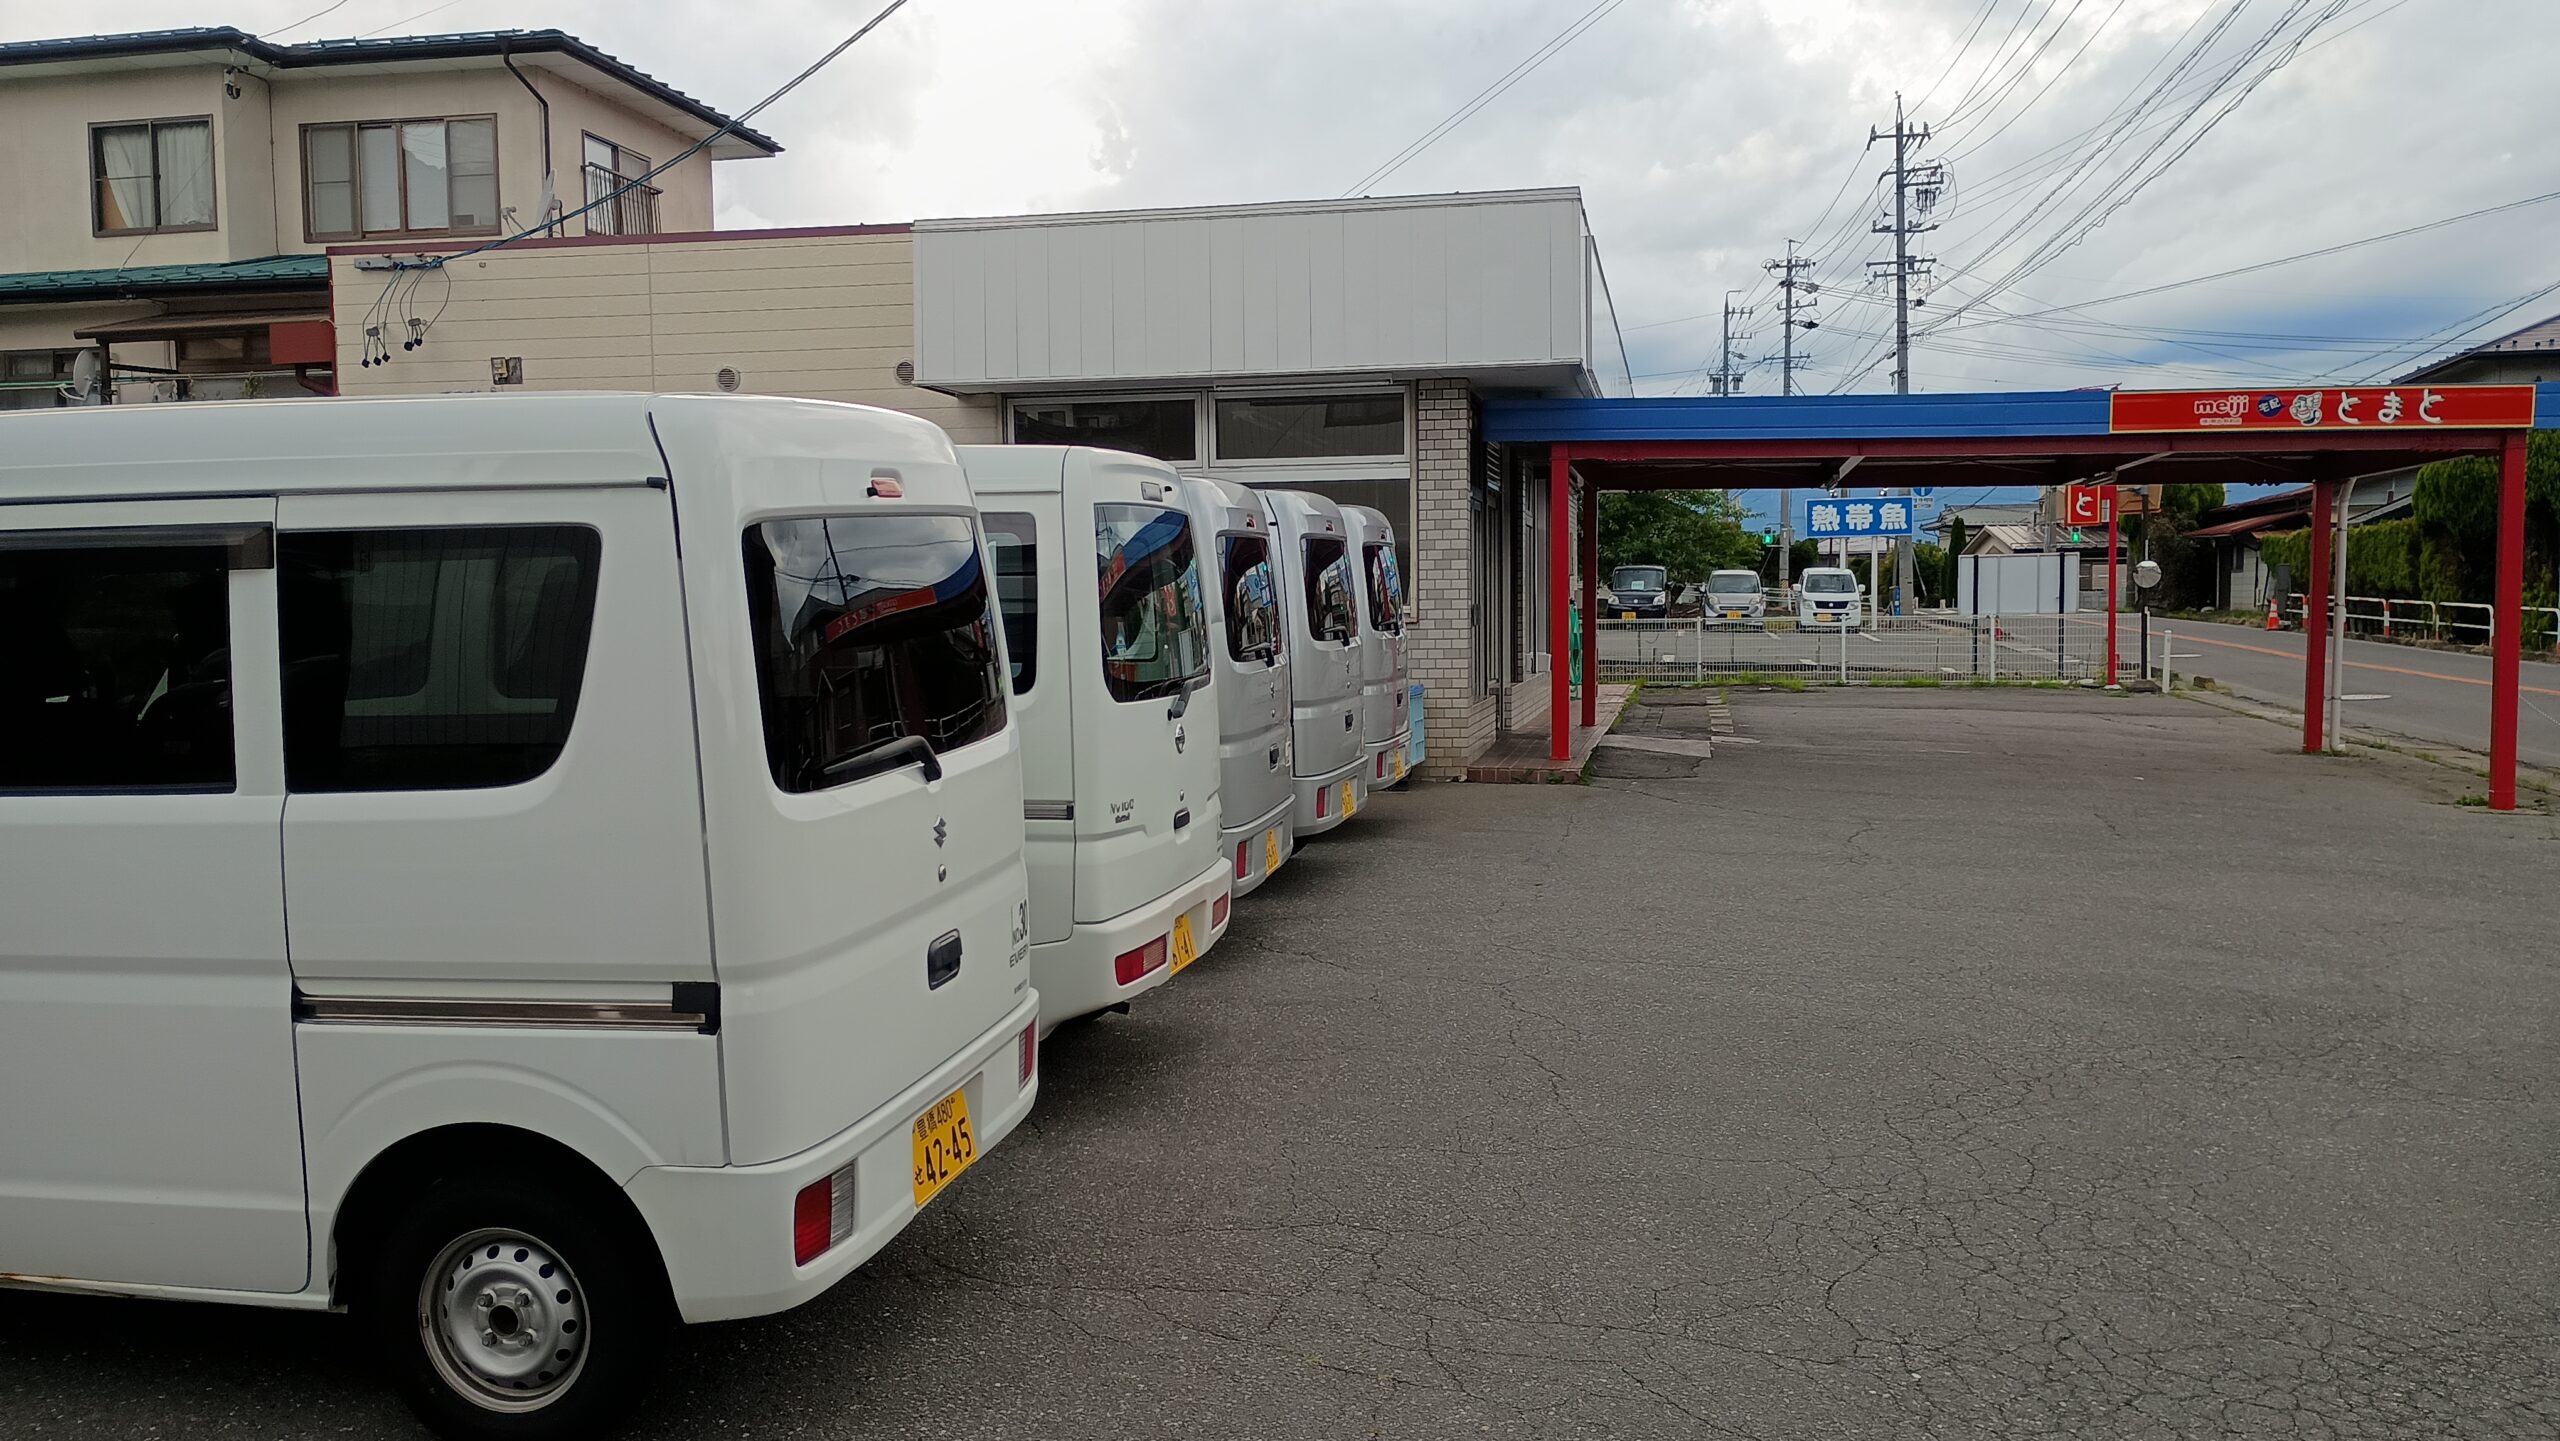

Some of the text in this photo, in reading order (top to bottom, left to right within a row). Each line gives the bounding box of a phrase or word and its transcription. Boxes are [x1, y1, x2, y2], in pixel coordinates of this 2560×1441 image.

[2194, 395, 2249, 417] meiji
[2258, 397, 2282, 413] 宅配
[2338, 388, 2444, 424] とまと
[1811, 502, 1908, 532] 熱帯魚
[2075, 491, 2094, 517] と
[925, 1116, 972, 1186] 42-45
